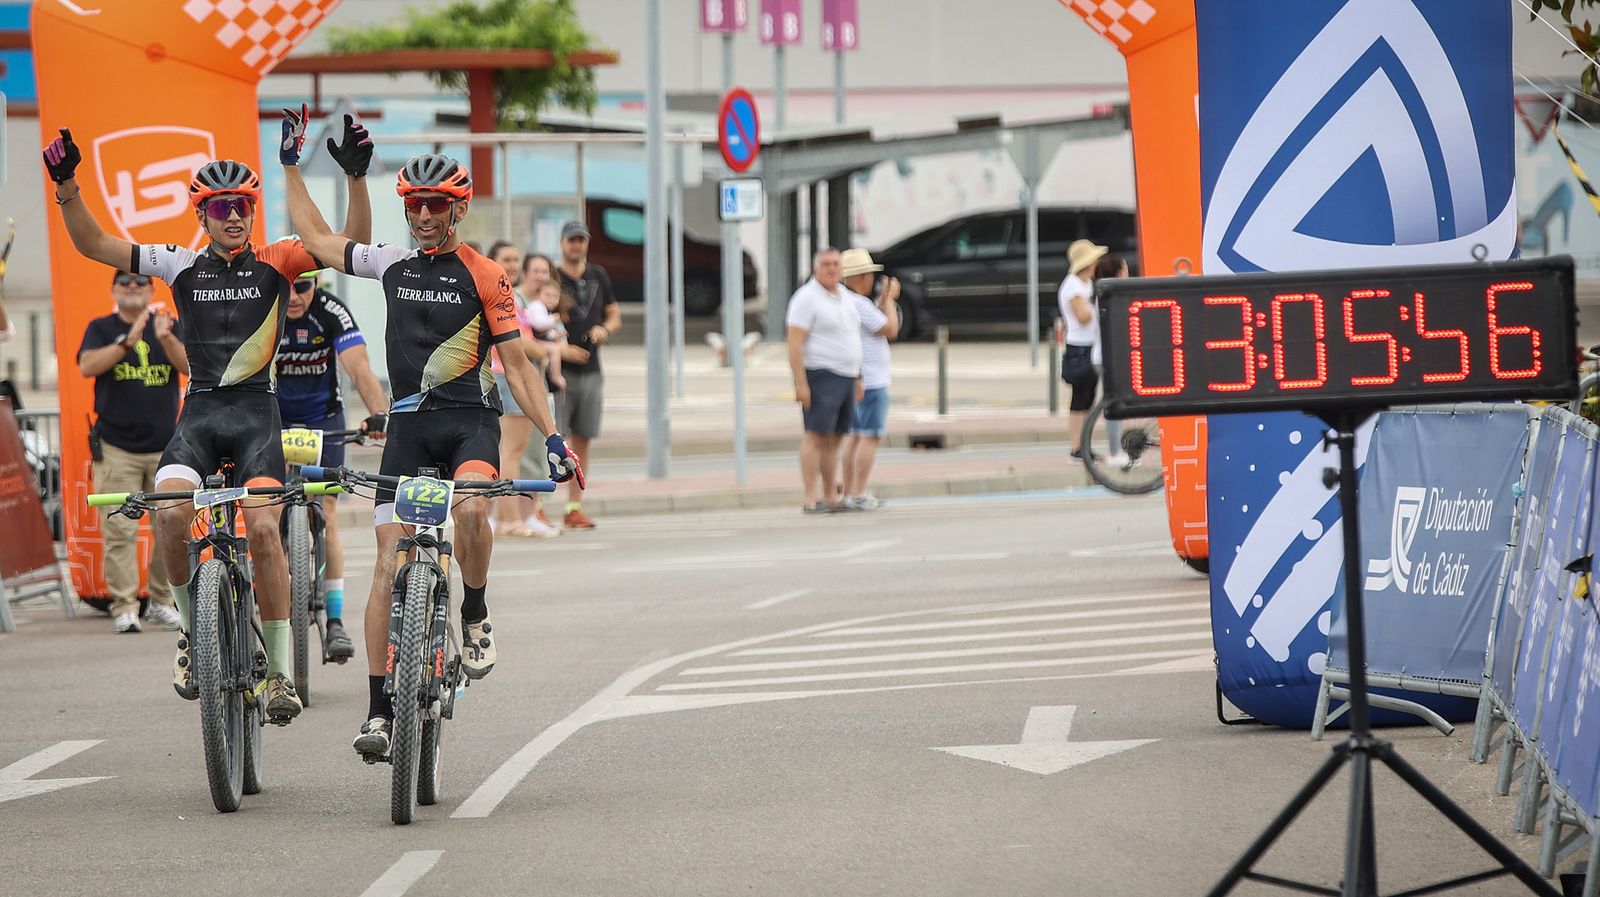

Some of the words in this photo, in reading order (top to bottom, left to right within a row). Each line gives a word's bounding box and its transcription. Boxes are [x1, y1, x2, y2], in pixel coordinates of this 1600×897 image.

[193, 286, 261, 301] TIERRABLANCA
[397, 287, 462, 304] TIERRABLANCA
[283, 436, 316, 449] 464
[403, 486, 447, 505] 122
[1424, 486, 1493, 538] Diputación
[1413, 552, 1430, 596] de
[1433, 552, 1469, 596] Cádiz
